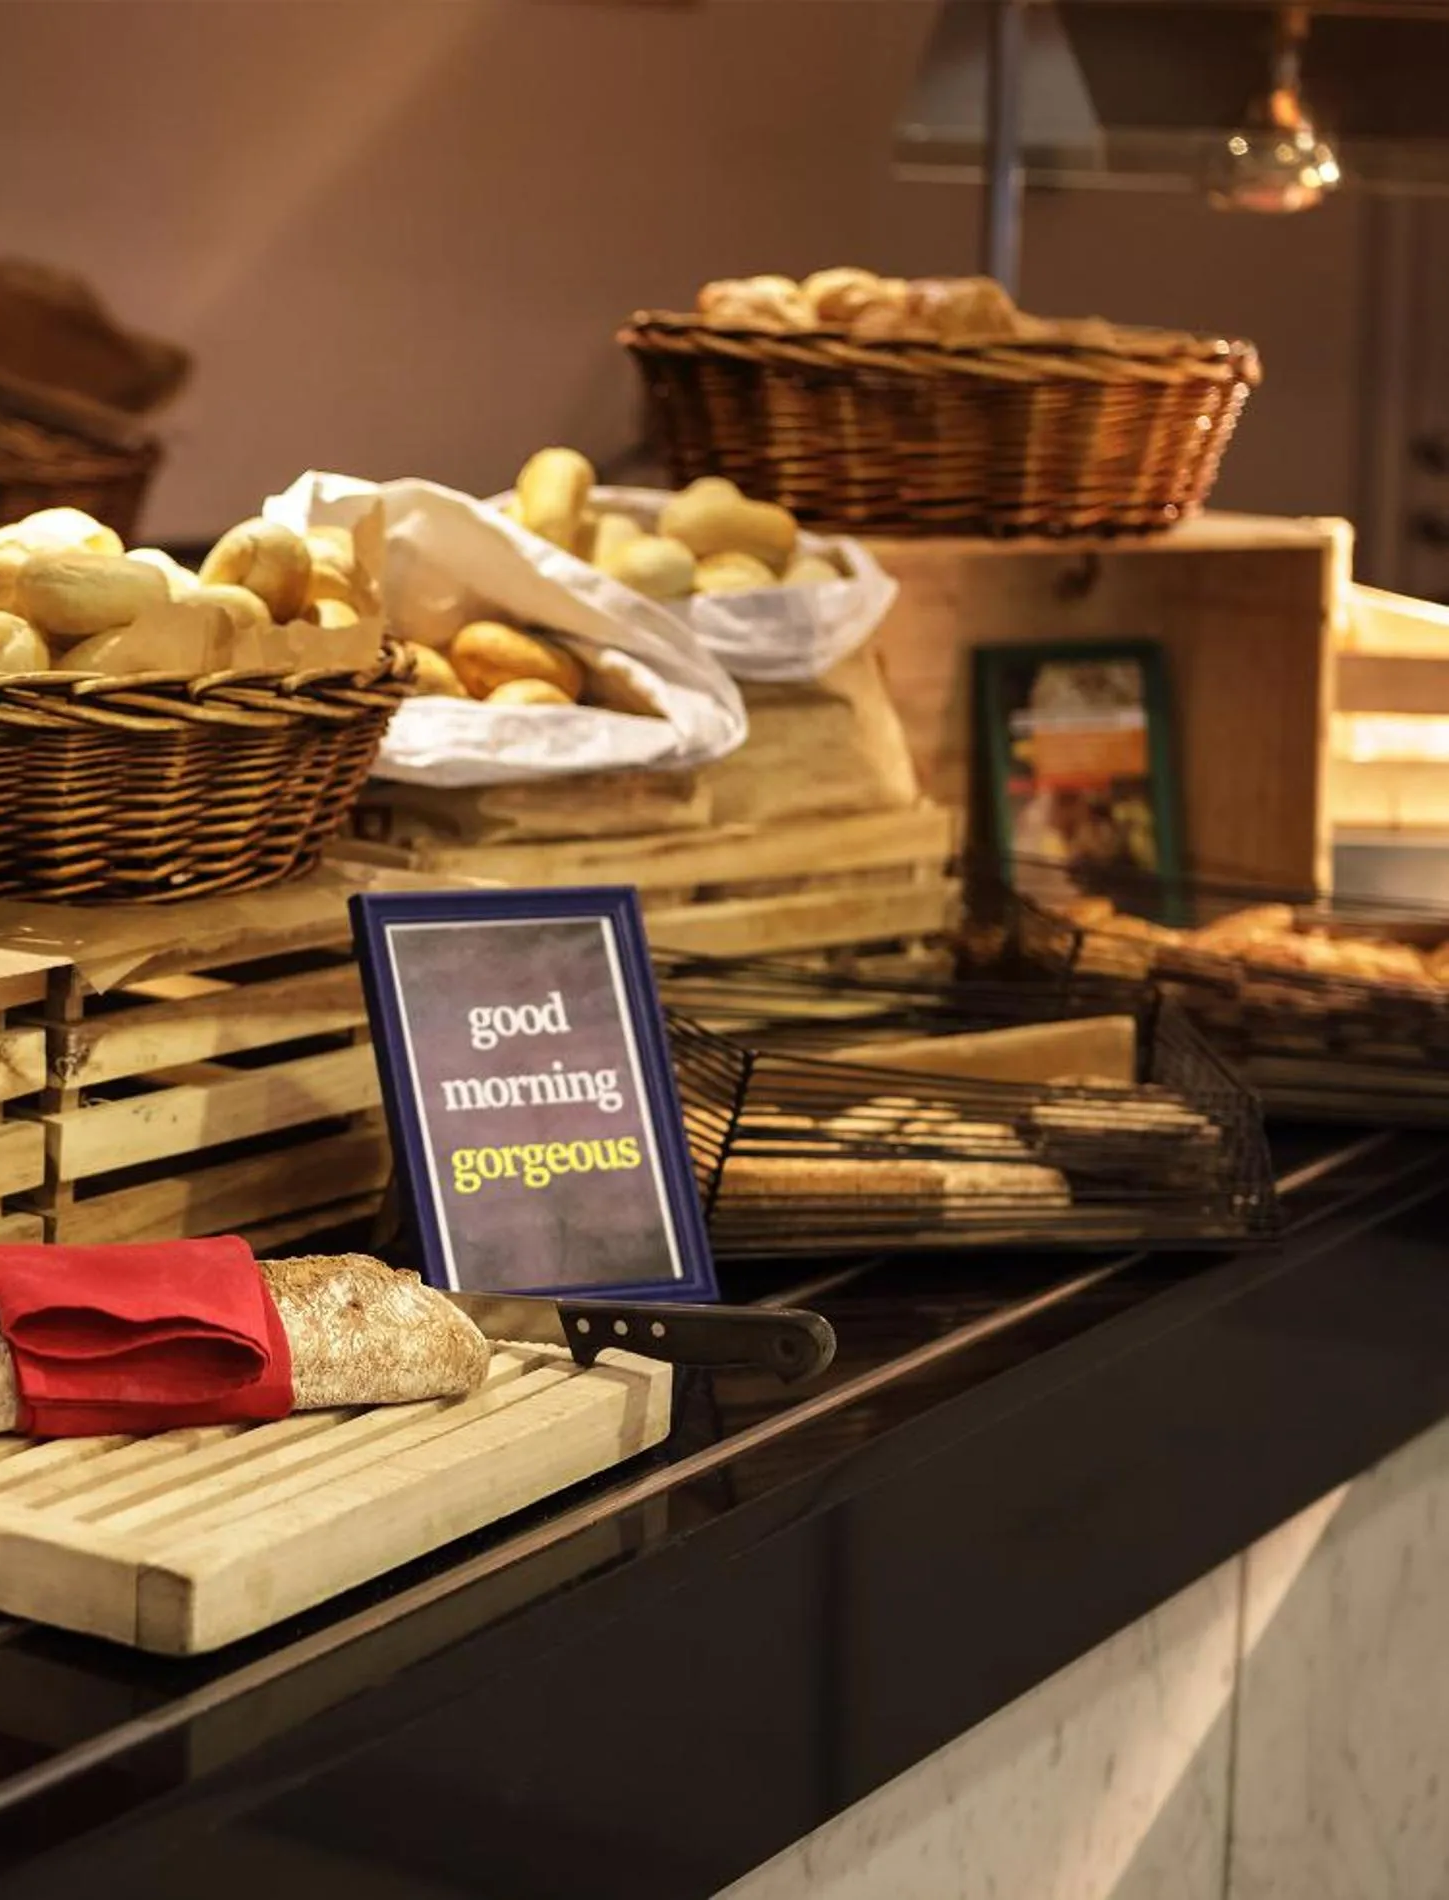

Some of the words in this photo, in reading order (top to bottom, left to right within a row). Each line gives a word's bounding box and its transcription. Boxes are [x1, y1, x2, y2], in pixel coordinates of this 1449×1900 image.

[468, 990, 570, 1050] good
[441, 1061, 623, 1113] morning
[451, 1136, 641, 1193] gorgeous
